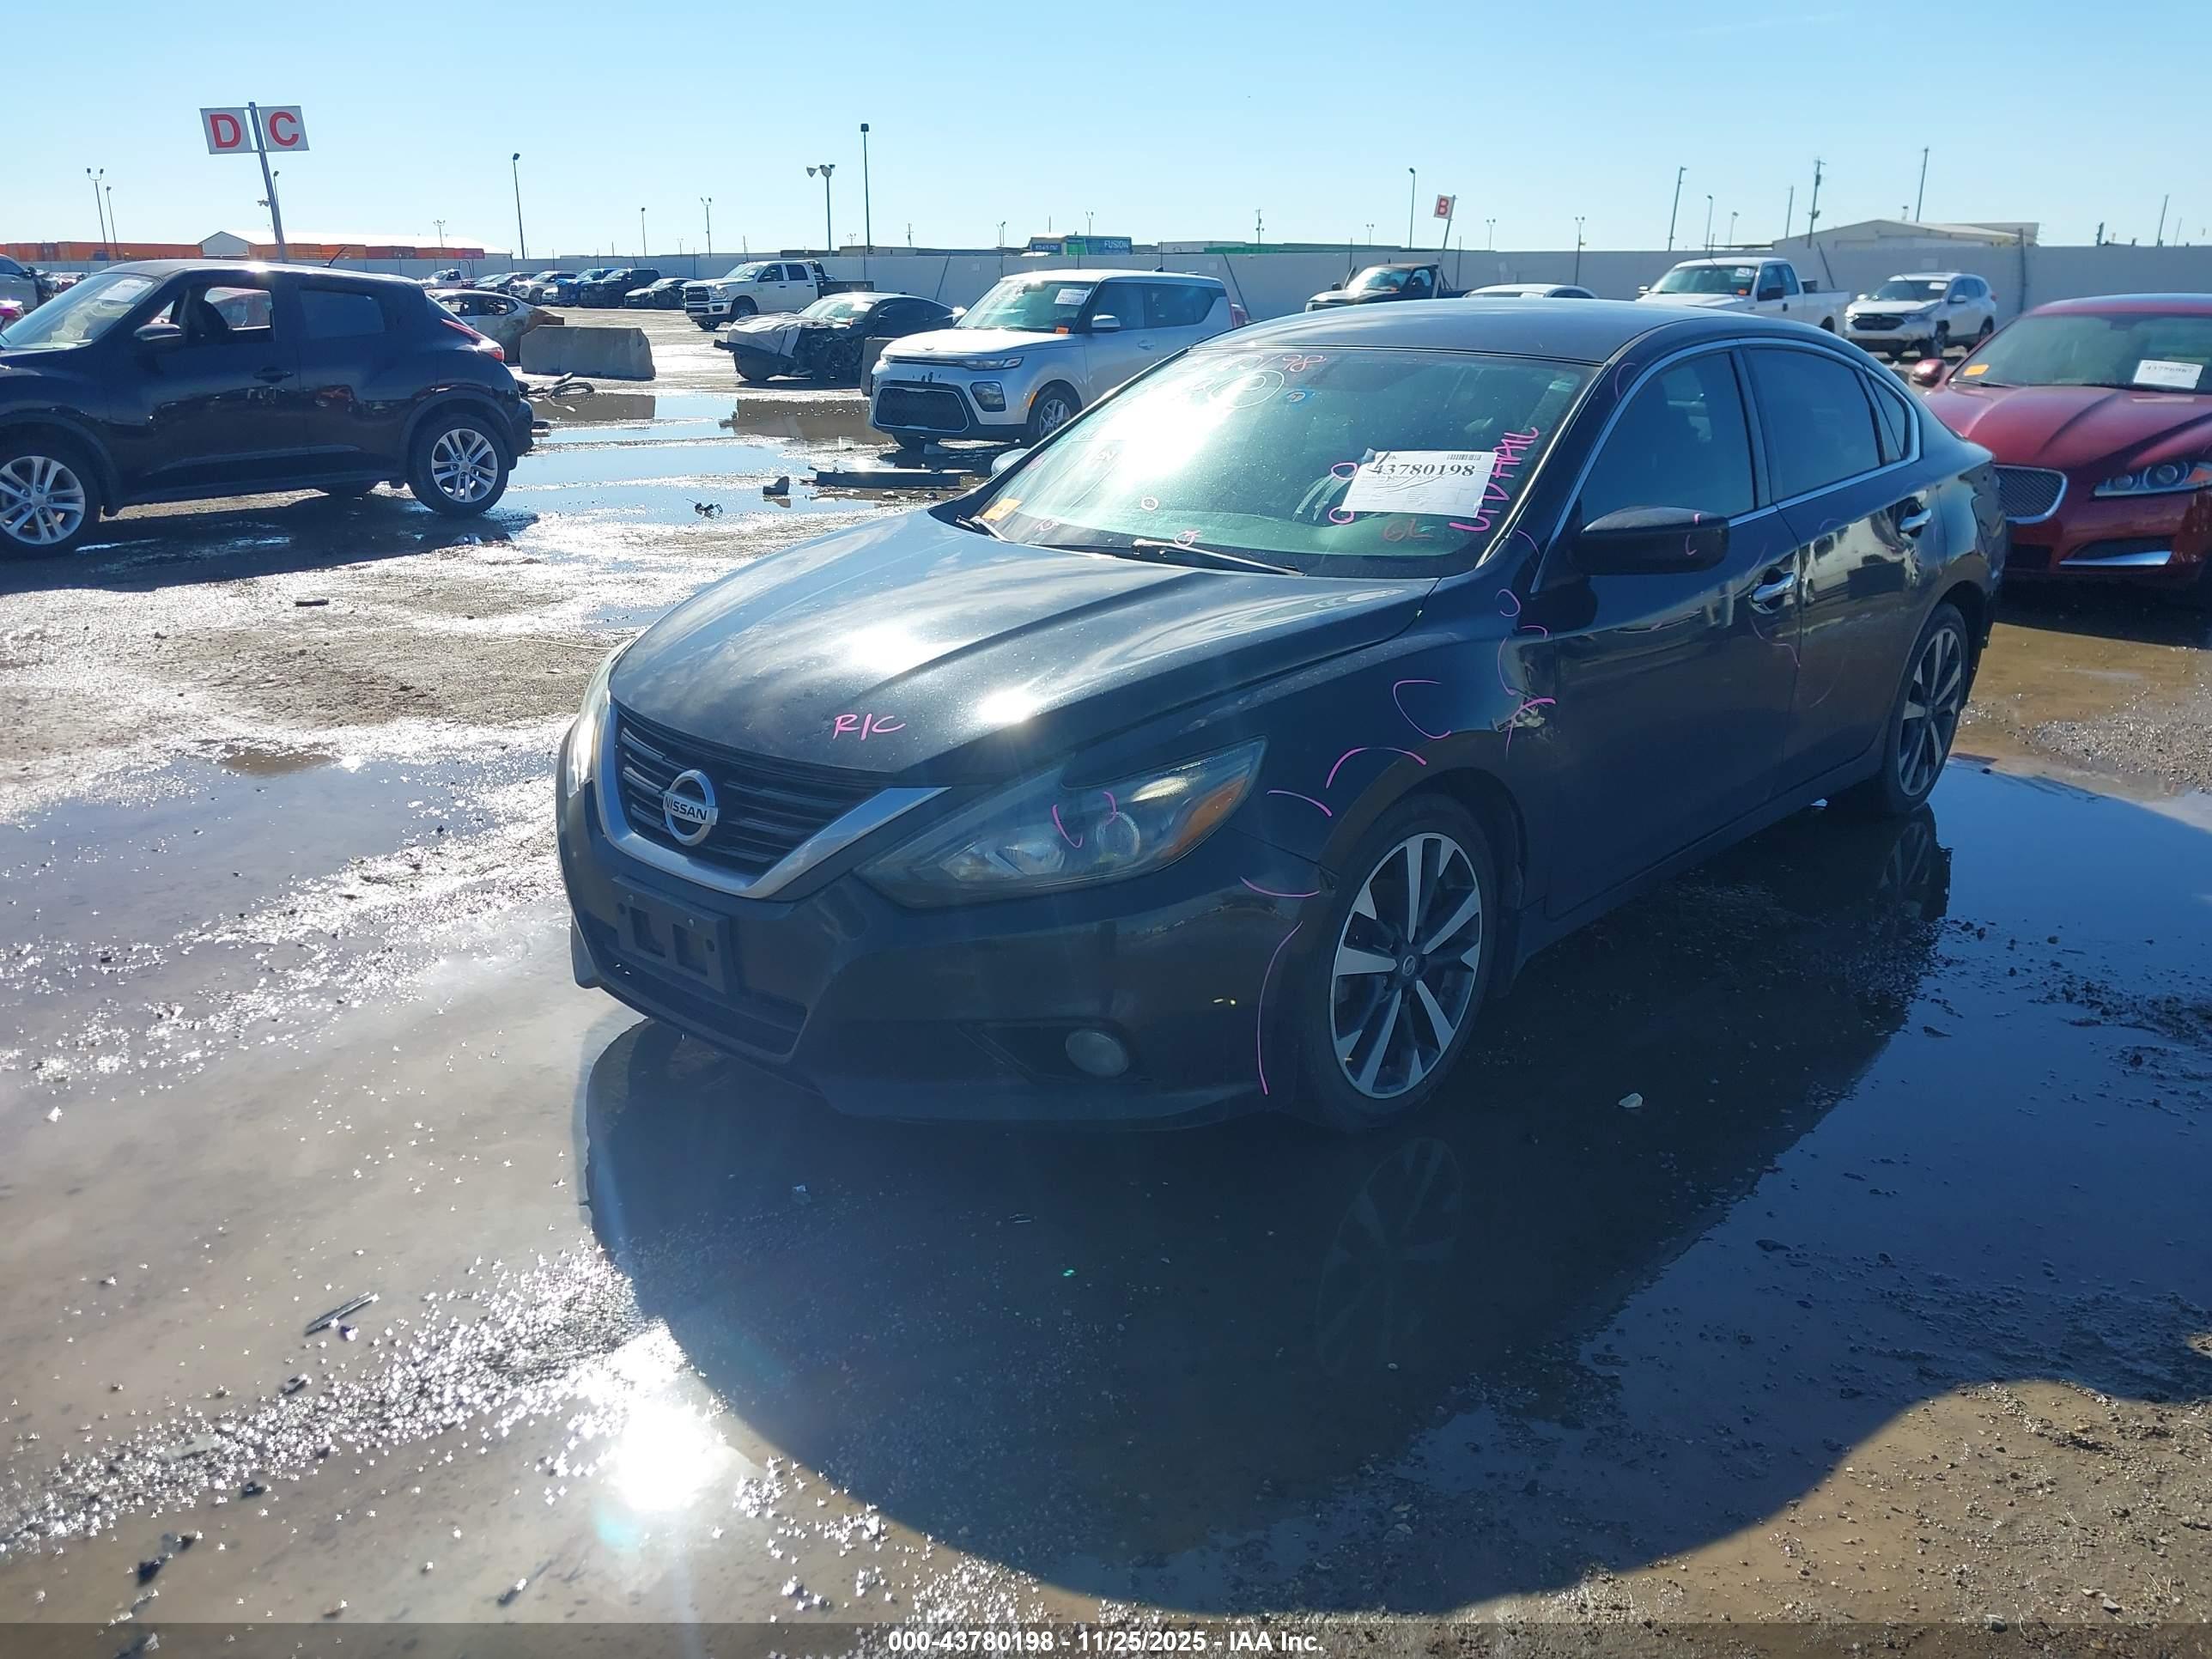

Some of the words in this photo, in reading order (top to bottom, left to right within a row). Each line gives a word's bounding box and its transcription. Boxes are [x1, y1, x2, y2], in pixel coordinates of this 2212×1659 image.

[210, 113, 242, 148] D
[269, 111, 300, 147] C
[1437, 198, 1449, 216] B
[1369, 463, 1476, 477] 43780198
[664, 795, 708, 821] NISSAN
